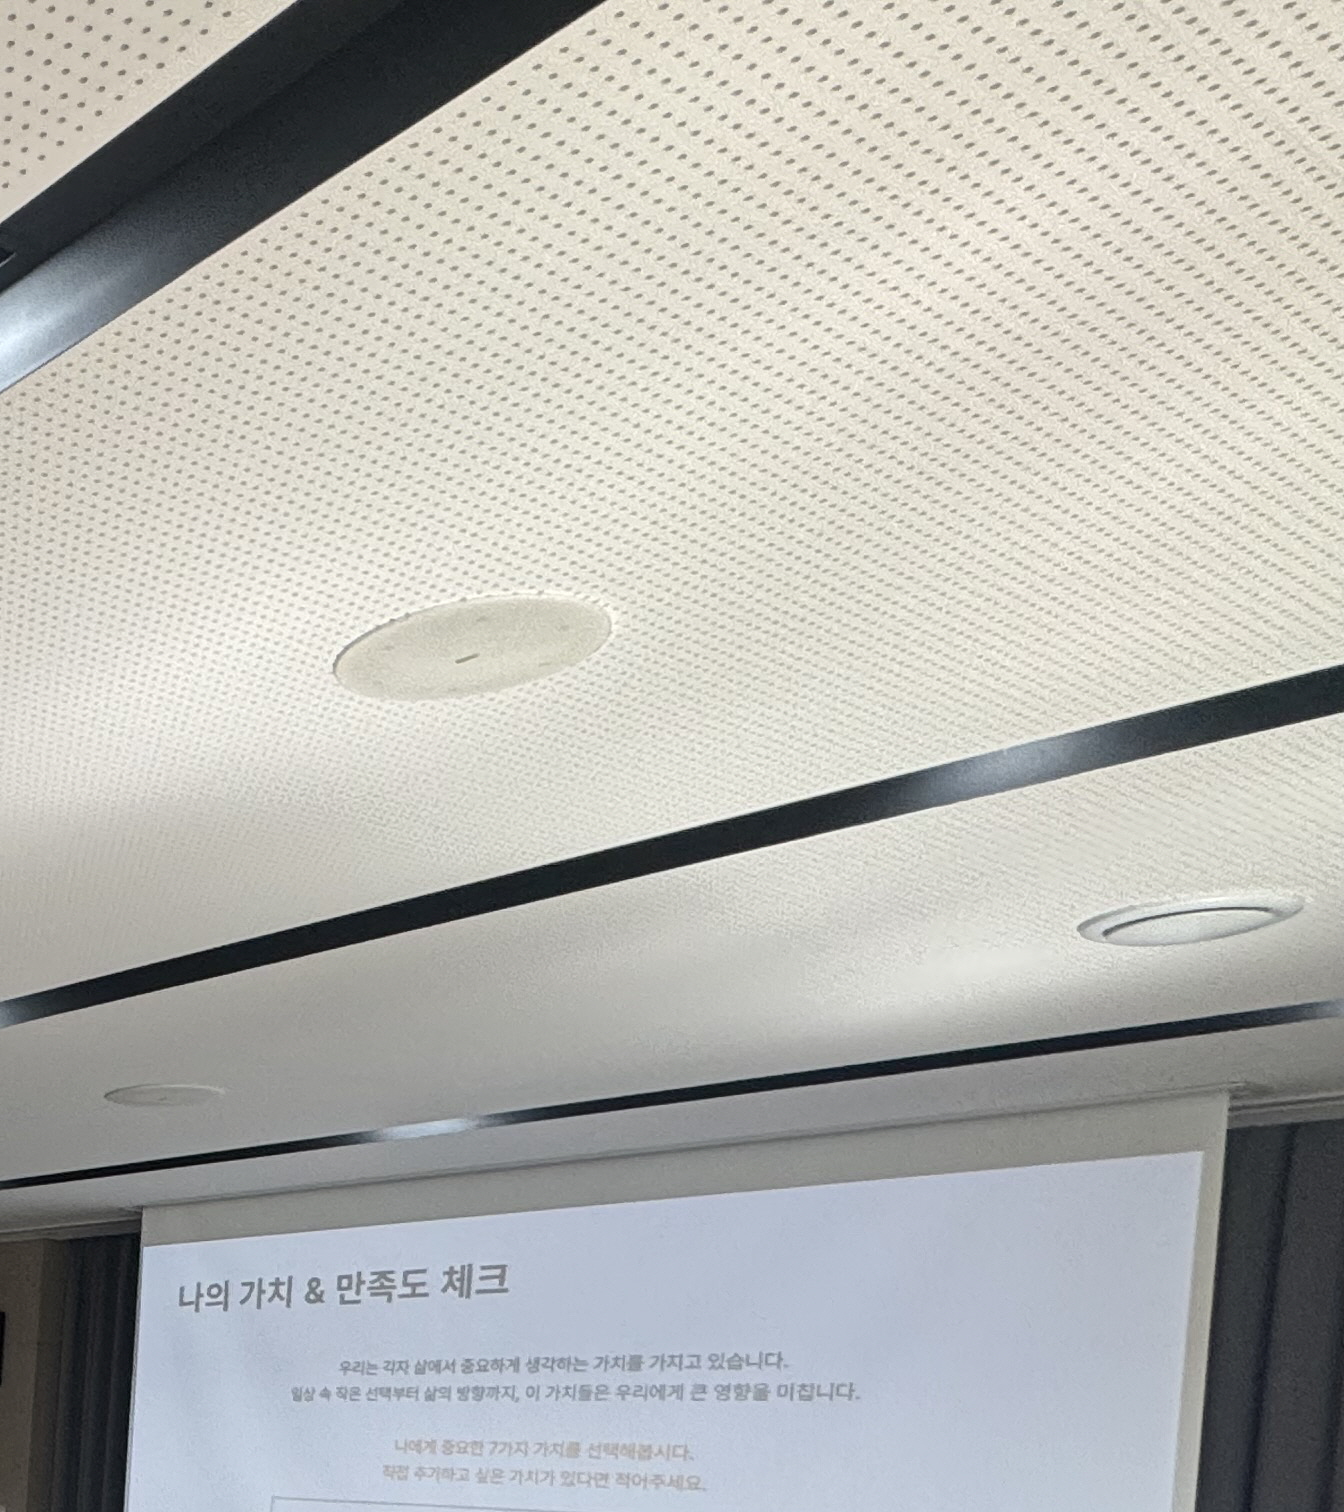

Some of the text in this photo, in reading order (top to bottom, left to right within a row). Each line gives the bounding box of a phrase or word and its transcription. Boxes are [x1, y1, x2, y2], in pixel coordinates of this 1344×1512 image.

[178, 1262, 510, 1313] 나의 가치 & 만족도 체크
[338, 1350, 790, 1376] 우리는 각자 삶에서 중요하게 생각하는 가치를 가지고 있습니다.
[291, 1381, 861, 1403] 일상 속 작은 선택부터 삶의 방향까지, 이 가치들은 우리에게 큰 영향을 미칩니다.
[394, 1438, 696, 1462] 나에게 중요한 7가지 가치를 선택해봅시다.
[382, 1464, 708, 1493] 직접 추가하고 싶은 가치가 있다면 적어주세요.
